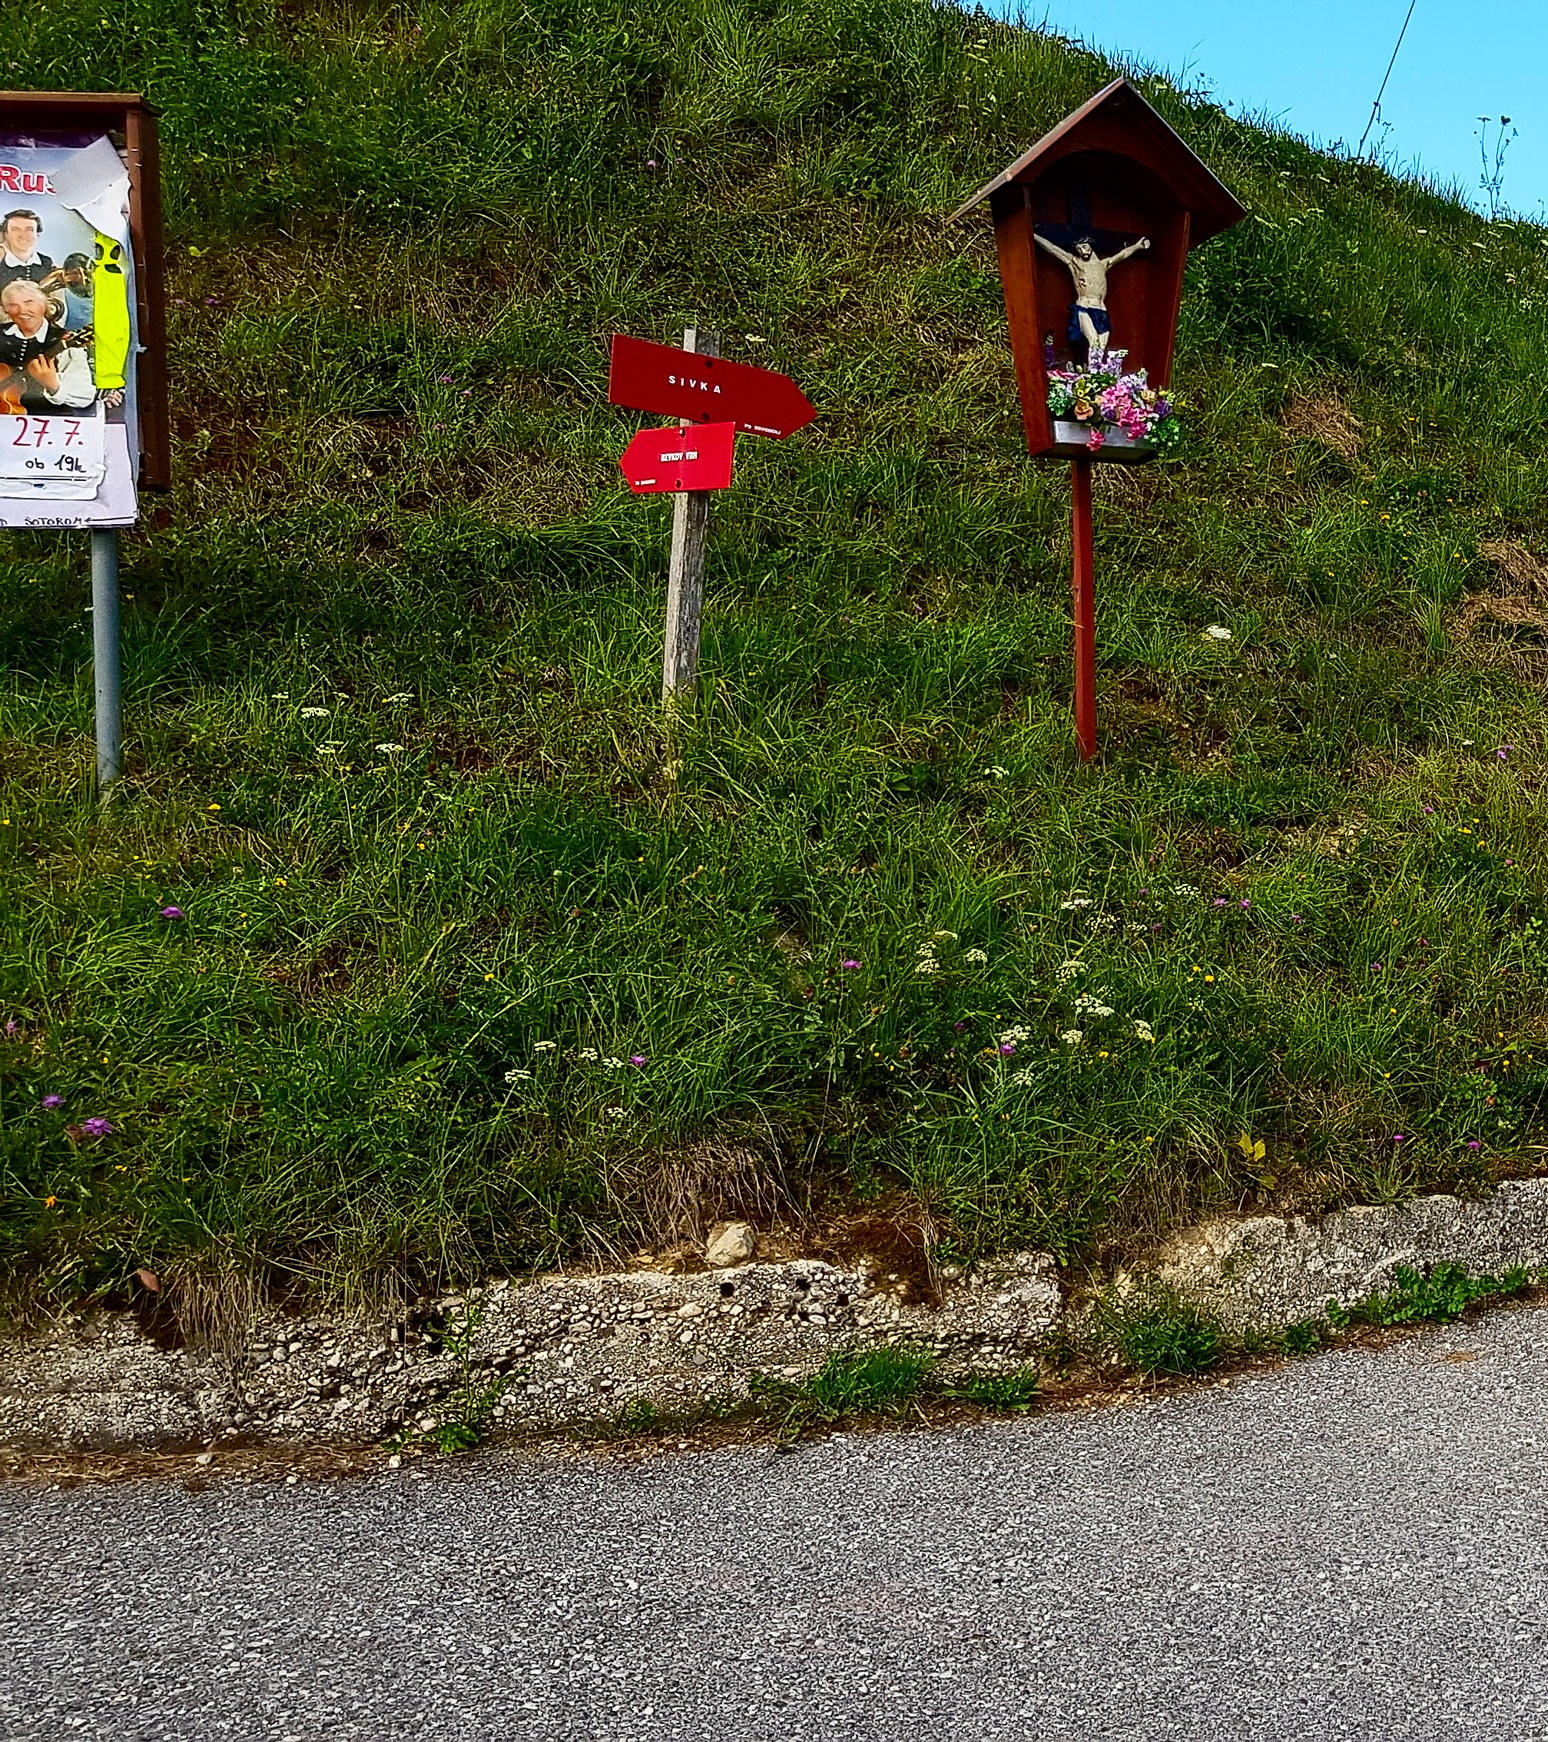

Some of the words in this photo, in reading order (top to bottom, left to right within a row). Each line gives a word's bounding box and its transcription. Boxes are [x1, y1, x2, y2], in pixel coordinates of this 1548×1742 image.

[0, 164, 56, 195] Ru
[668, 375, 721, 394] SIVKA
[12, 417, 53, 448] 27.
[63, 419, 84, 446] 7.
[25, 457, 45, 470] ob
